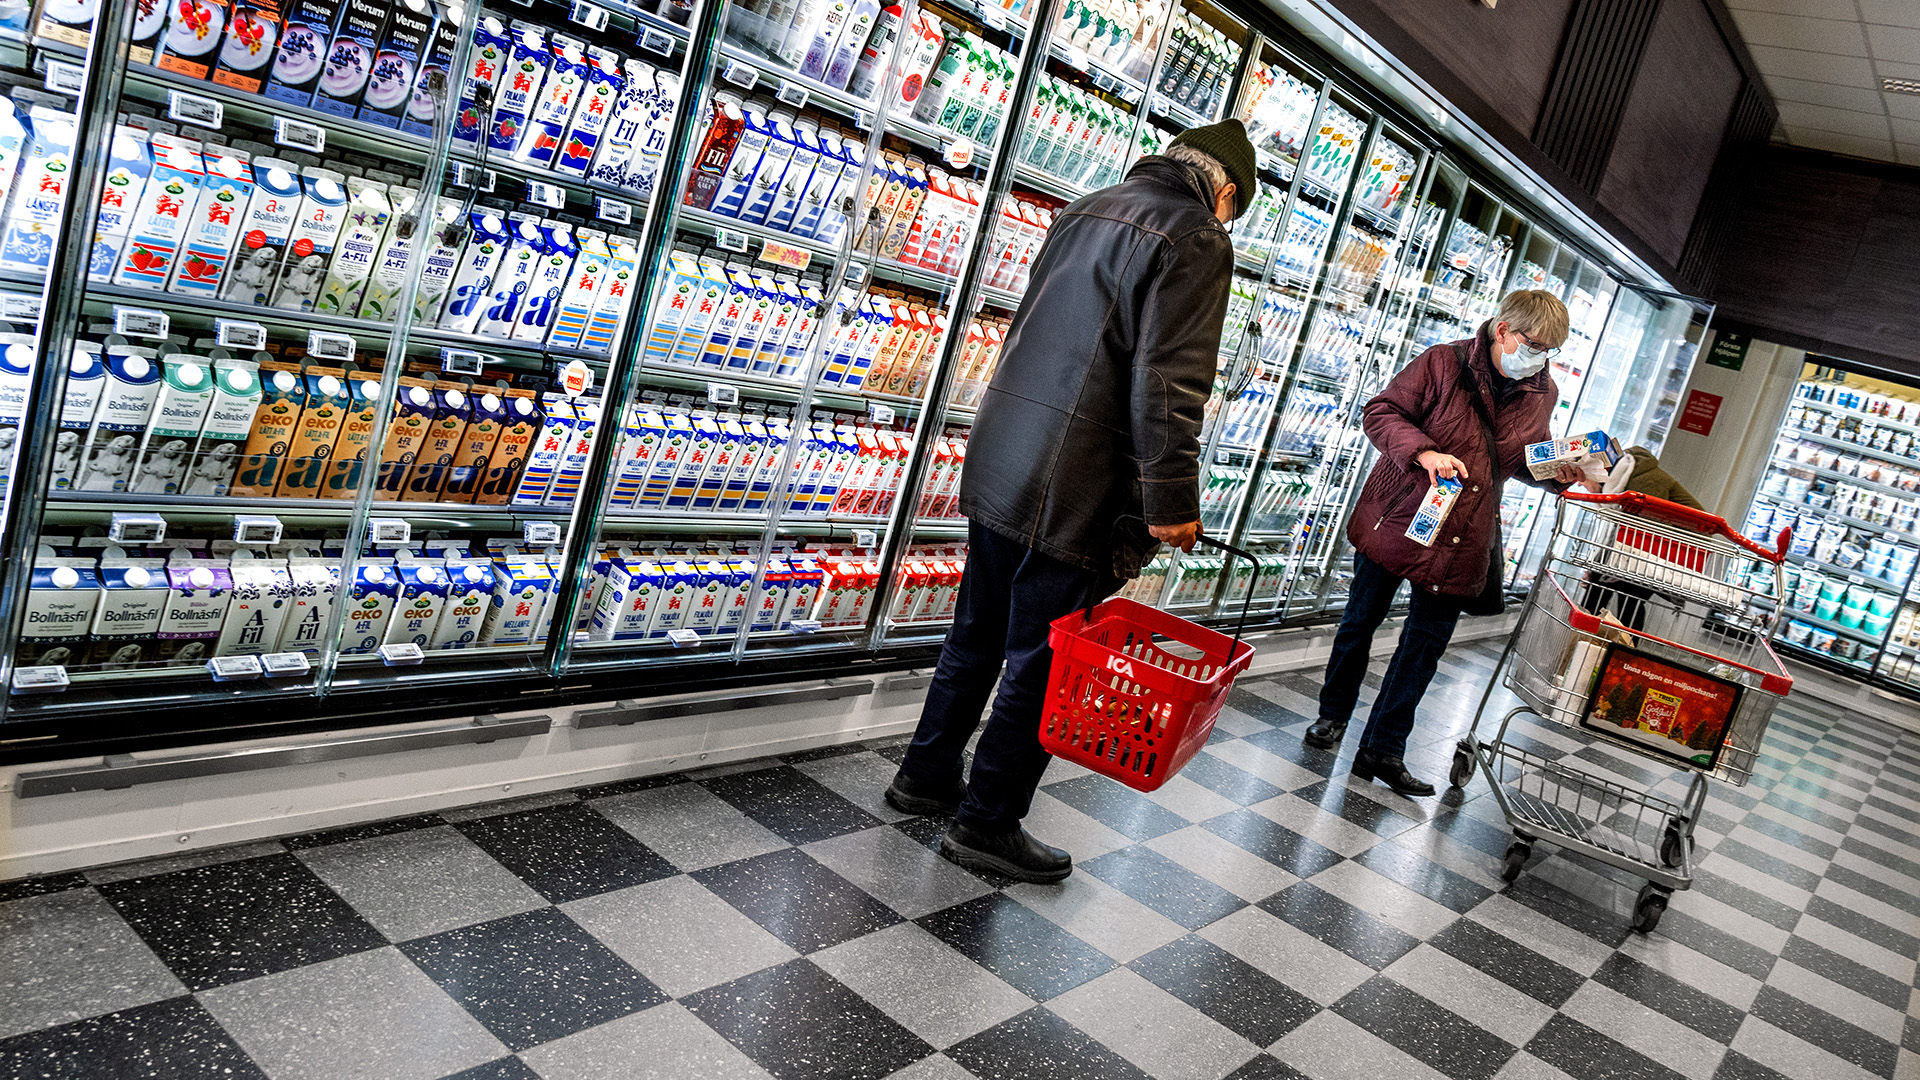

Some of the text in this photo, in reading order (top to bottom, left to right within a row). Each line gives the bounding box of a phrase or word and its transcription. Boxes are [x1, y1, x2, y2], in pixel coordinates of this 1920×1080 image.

[351, 0, 385, 18] Verum
[395, 12, 427, 32] Verum
[615, 118, 639, 142] Fil
[705, 149, 725, 168] FIL
[253, 210, 290, 226] Bollnäsfil
[301, 218, 337, 234] Bollnäsfil
[341, 251, 368, 263] A-FIL
[384, 259, 407, 271] A-FI
[424, 266, 449, 278] A-FIL
[567, 375, 582, 387] PRIS!
[120, 393, 144, 401] Original
[108, 400, 149, 412] Bollnäsfil
[162, 407, 201, 418] Bollnäsfil
[213, 411, 251, 421] Bollnäsfil
[260, 414, 293, 426] eko
[305, 418, 337, 430] eko
[395, 426, 423, 438] eko
[431, 428, 459, 441] eko
[468, 431, 495, 443] eko
[397, 437, 411, 447] A-FIL
[434, 438, 448, 448] A-FIL
[502, 433, 528, 444] eko
[470, 442, 484, 451] A-FIL
[505, 443, 518, 453] A-FIL
[28, 610, 88, 624] Bollnäsfil
[104, 608, 159, 622] Bollnäsfil
[170, 608, 223, 621] Bollnäsfil
[351, 609, 383, 621] eko
[403, 608, 434, 619] eko
[453, 606, 481, 617] eko
[355, 620, 371, 631] A-FIL
[407, 620, 422, 630] A-FIL
[456, 616, 470, 627] A-FIL
[503, 619, 530, 629] MELLANFIL
[238, 626, 265, 645] Fil
[296, 622, 320, 641] Fil
[1106, 655, 1134, 679] ICA
[1623, 663, 1718, 700] Unna någon en miljonchans!
